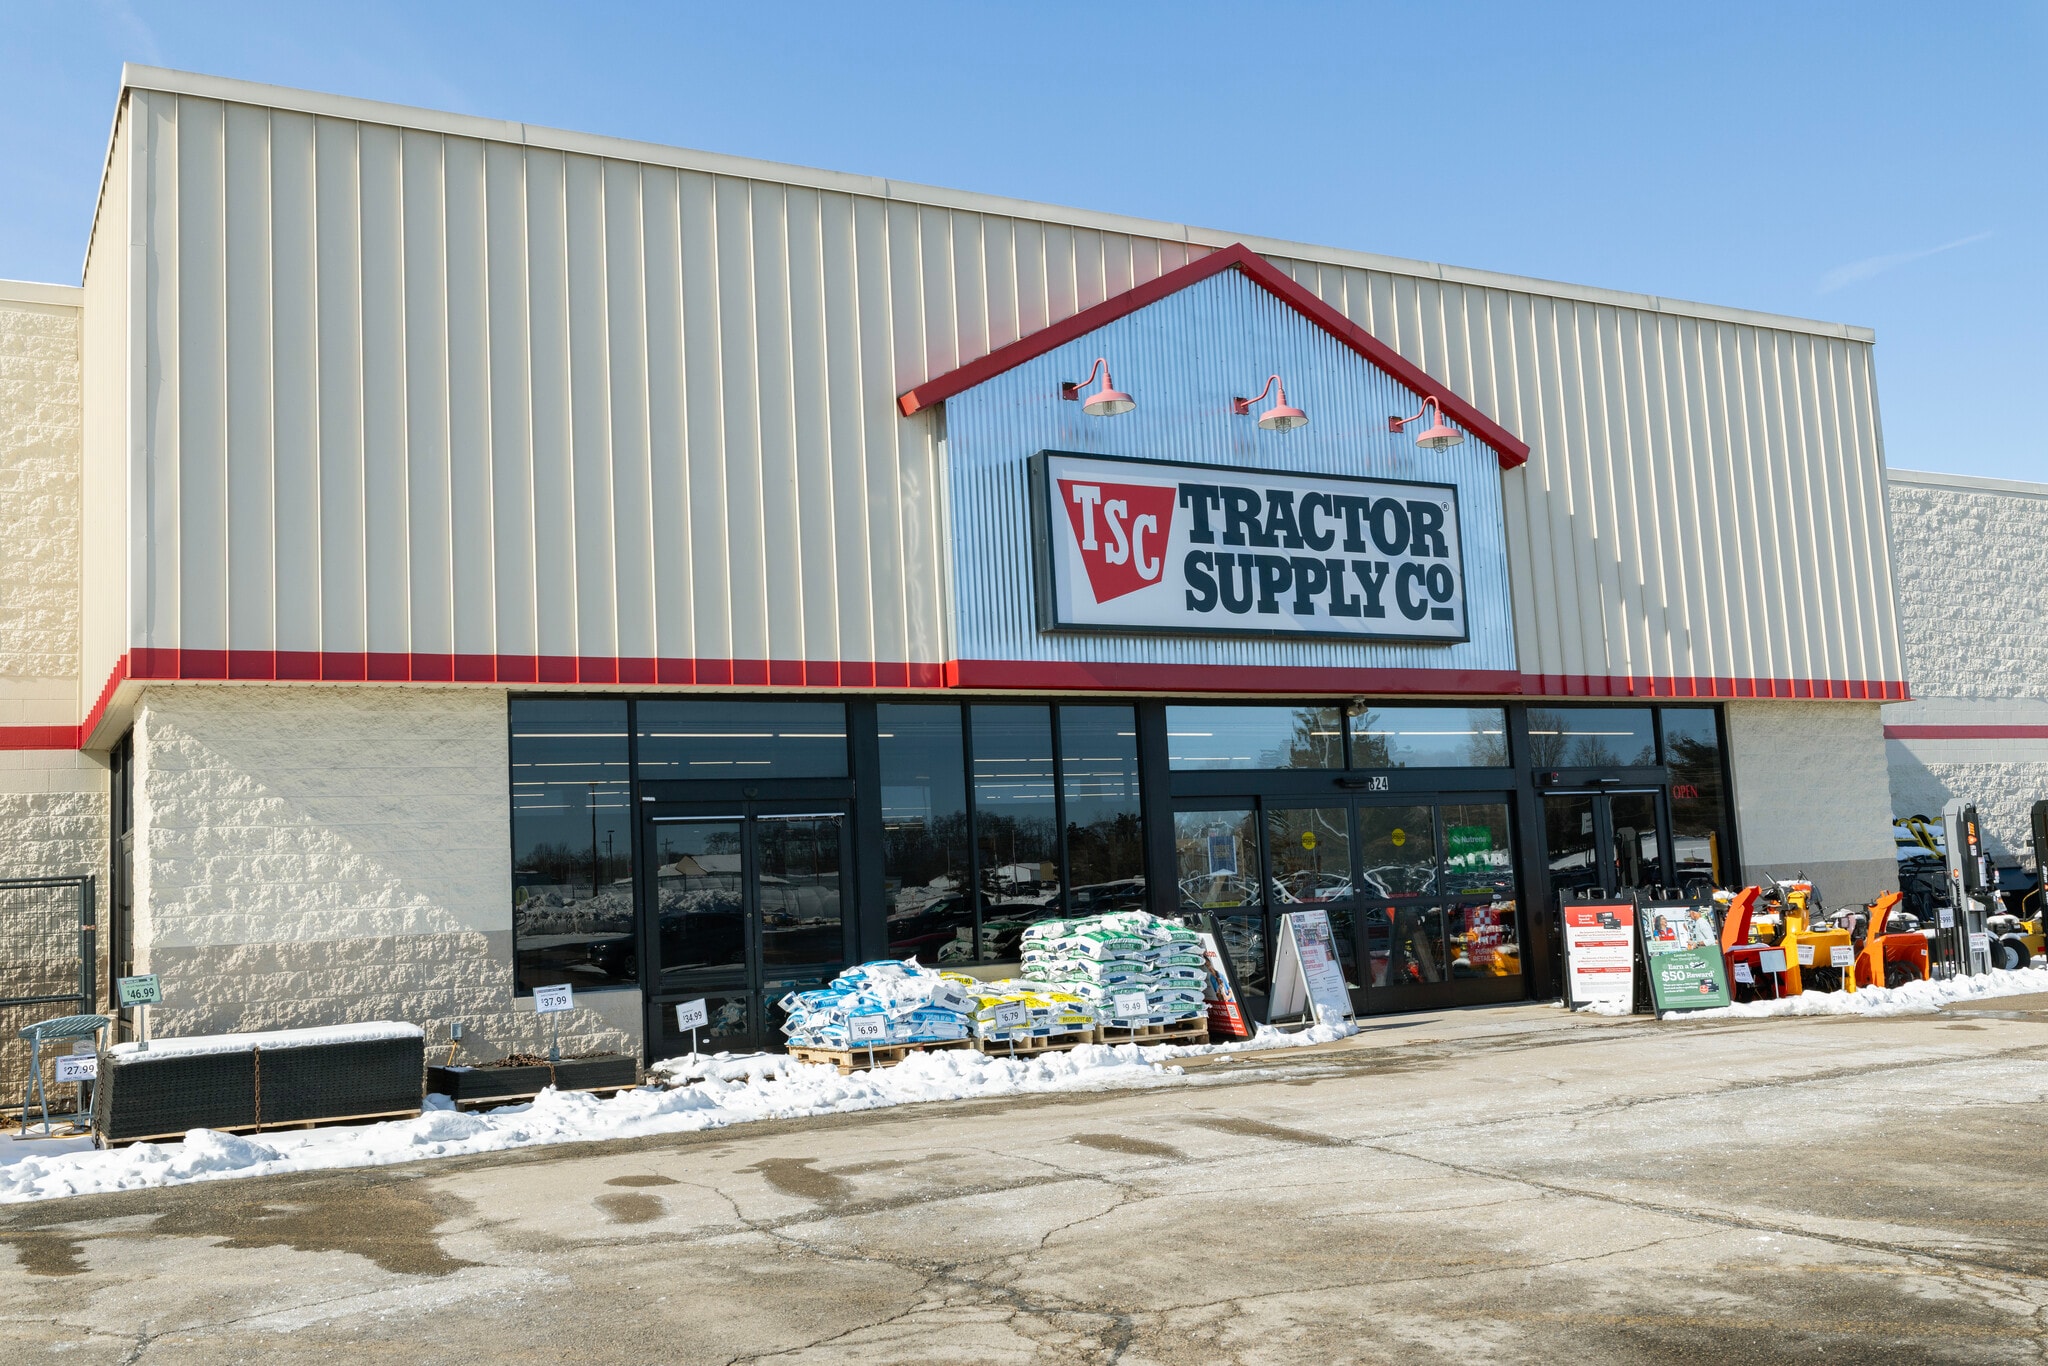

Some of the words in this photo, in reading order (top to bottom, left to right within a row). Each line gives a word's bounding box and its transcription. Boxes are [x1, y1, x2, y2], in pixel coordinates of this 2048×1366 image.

[1178, 483, 1449, 558] TRACTOR
[1073, 485, 1160, 580] TSC
[1184, 550, 1389, 619] SUPPLY
[1369, 777, 1387, 790] 824
[1673, 784, 1698, 799] OPEN
[1661, 970, 1685, 982] $50
[127, 987, 155, 999] $46.99
[541, 995, 567, 1007] $37.99
[1123, 1002, 1141, 1011] $9.49
[1002, 1012, 1019, 1022] $6.79
[858, 1025, 878, 1035] $6.99
[64, 1064, 95, 1075] $27.99
